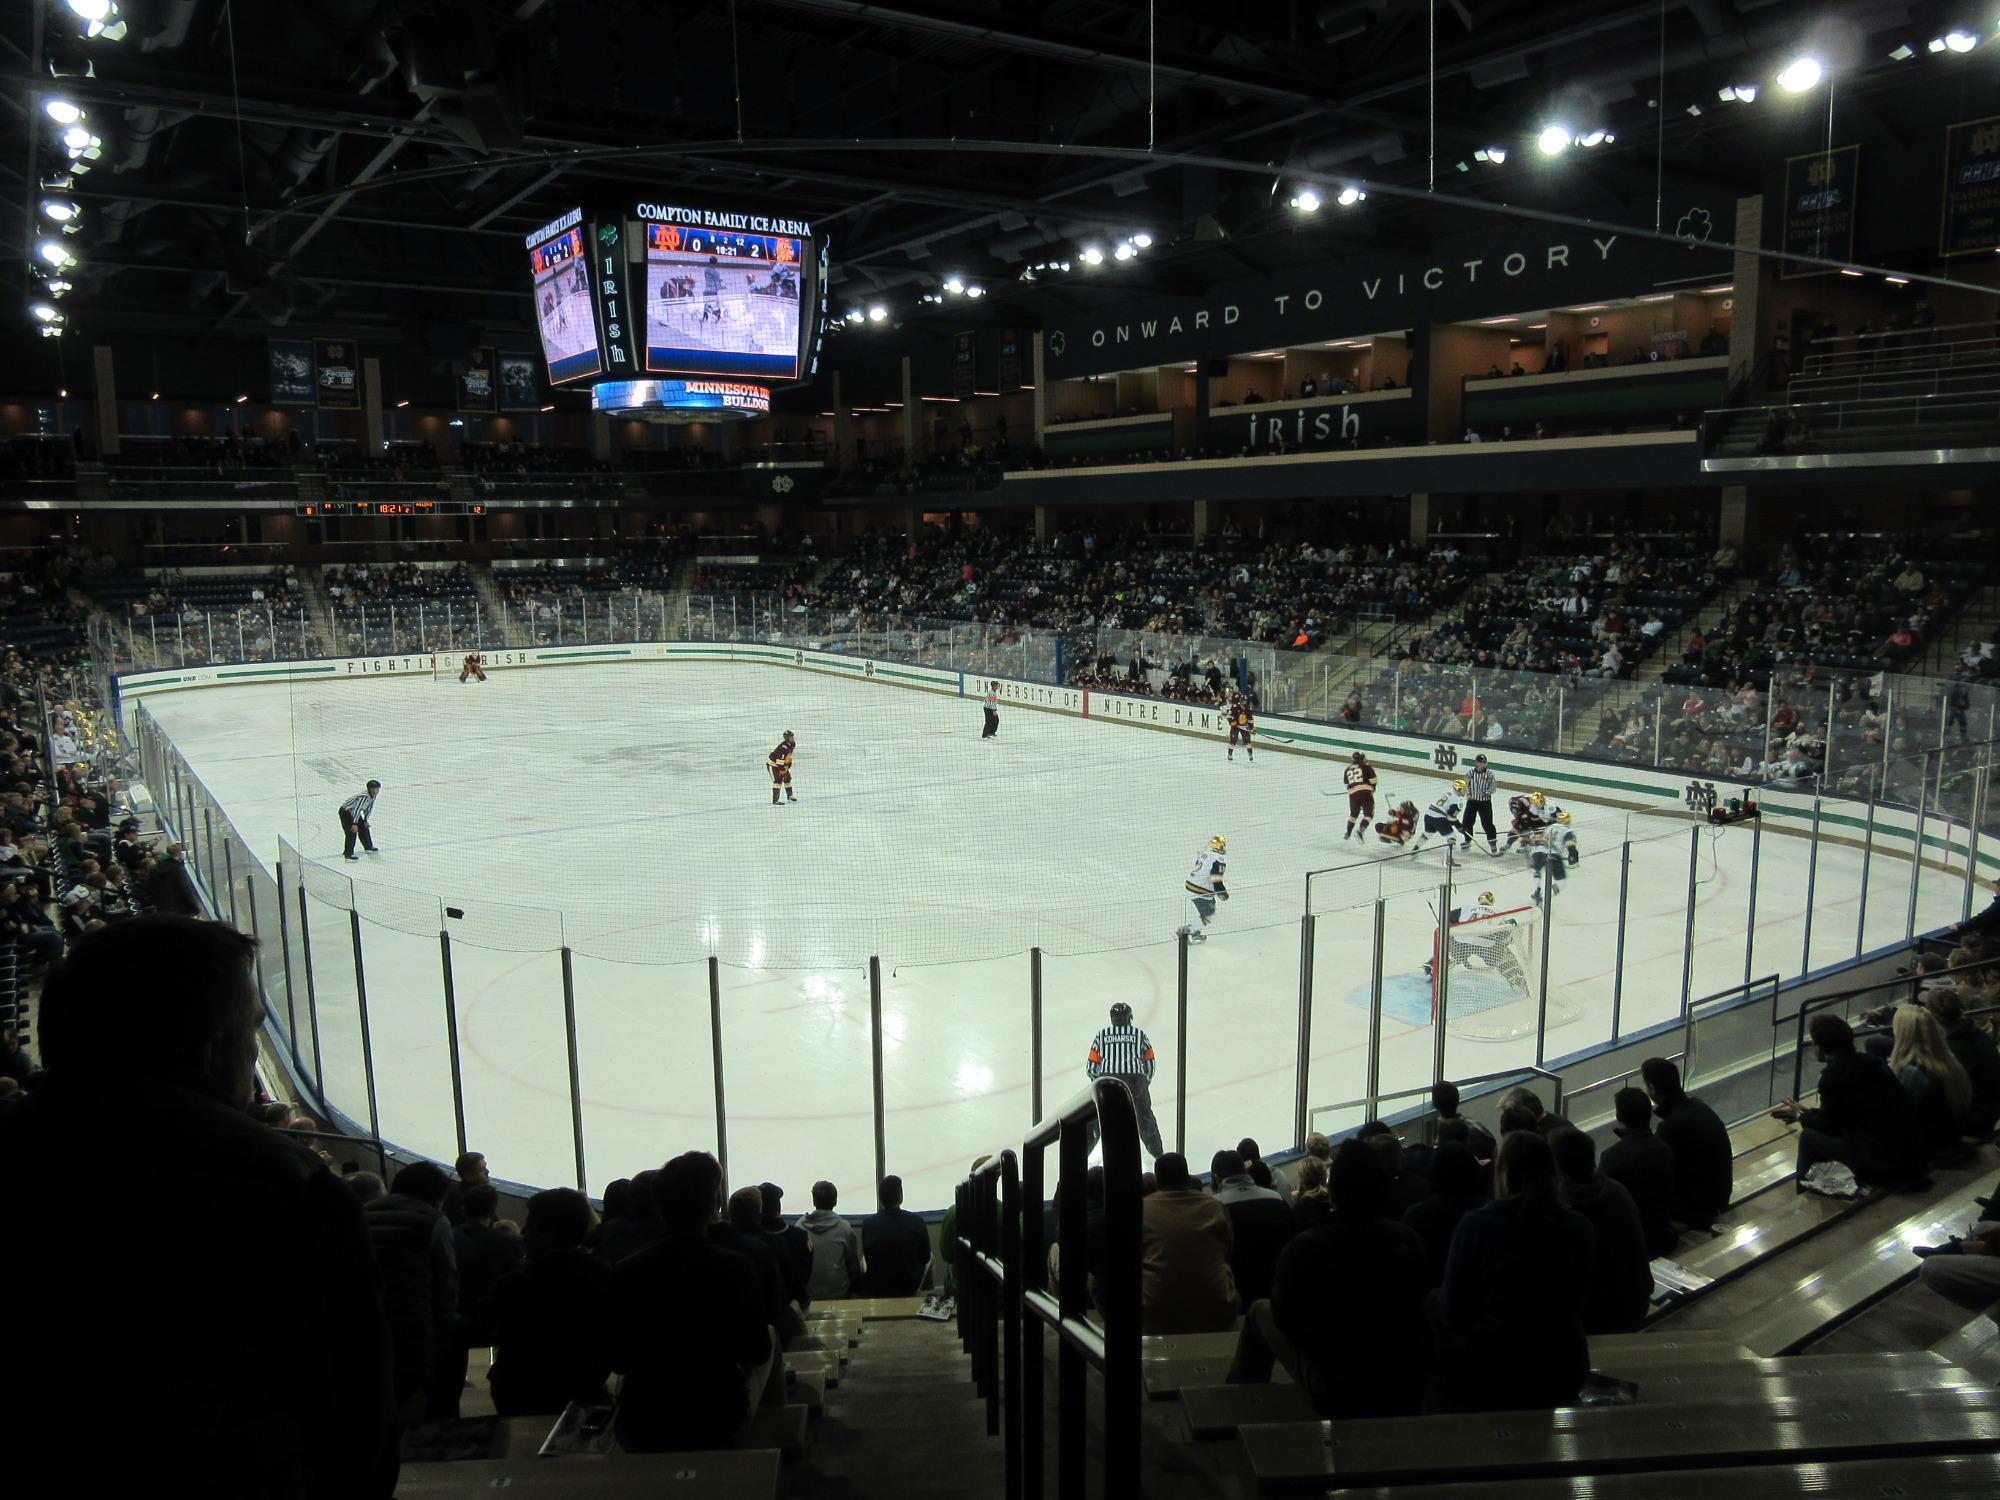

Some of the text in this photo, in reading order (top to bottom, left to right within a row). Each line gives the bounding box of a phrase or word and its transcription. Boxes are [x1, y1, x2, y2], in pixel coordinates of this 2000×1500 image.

[637, 204, 812, 237] COMPTON FAMILY ICE ARENA
[692, 239, 701, 252] 0
[735, 238, 745, 246] 12
[716, 245, 738, 257] 18:21
[750, 245, 759, 258] 2
[1092, 235, 1617, 347] ONWARD TO VICTORY
[685, 382, 759, 398] MINNESOTA
[379, 504, 402, 513] 18:21
[474, 506, 481, 514] 12
[348, 653, 526, 673] FIGHTING RISH
[976, 680, 1079, 707] UNVERSITY OF
[1104, 698, 1223, 731] NOTRE DAME
[1346, 769, 1364, 783] 22
[1104, 1034, 1137, 1044] KOHARSKI
